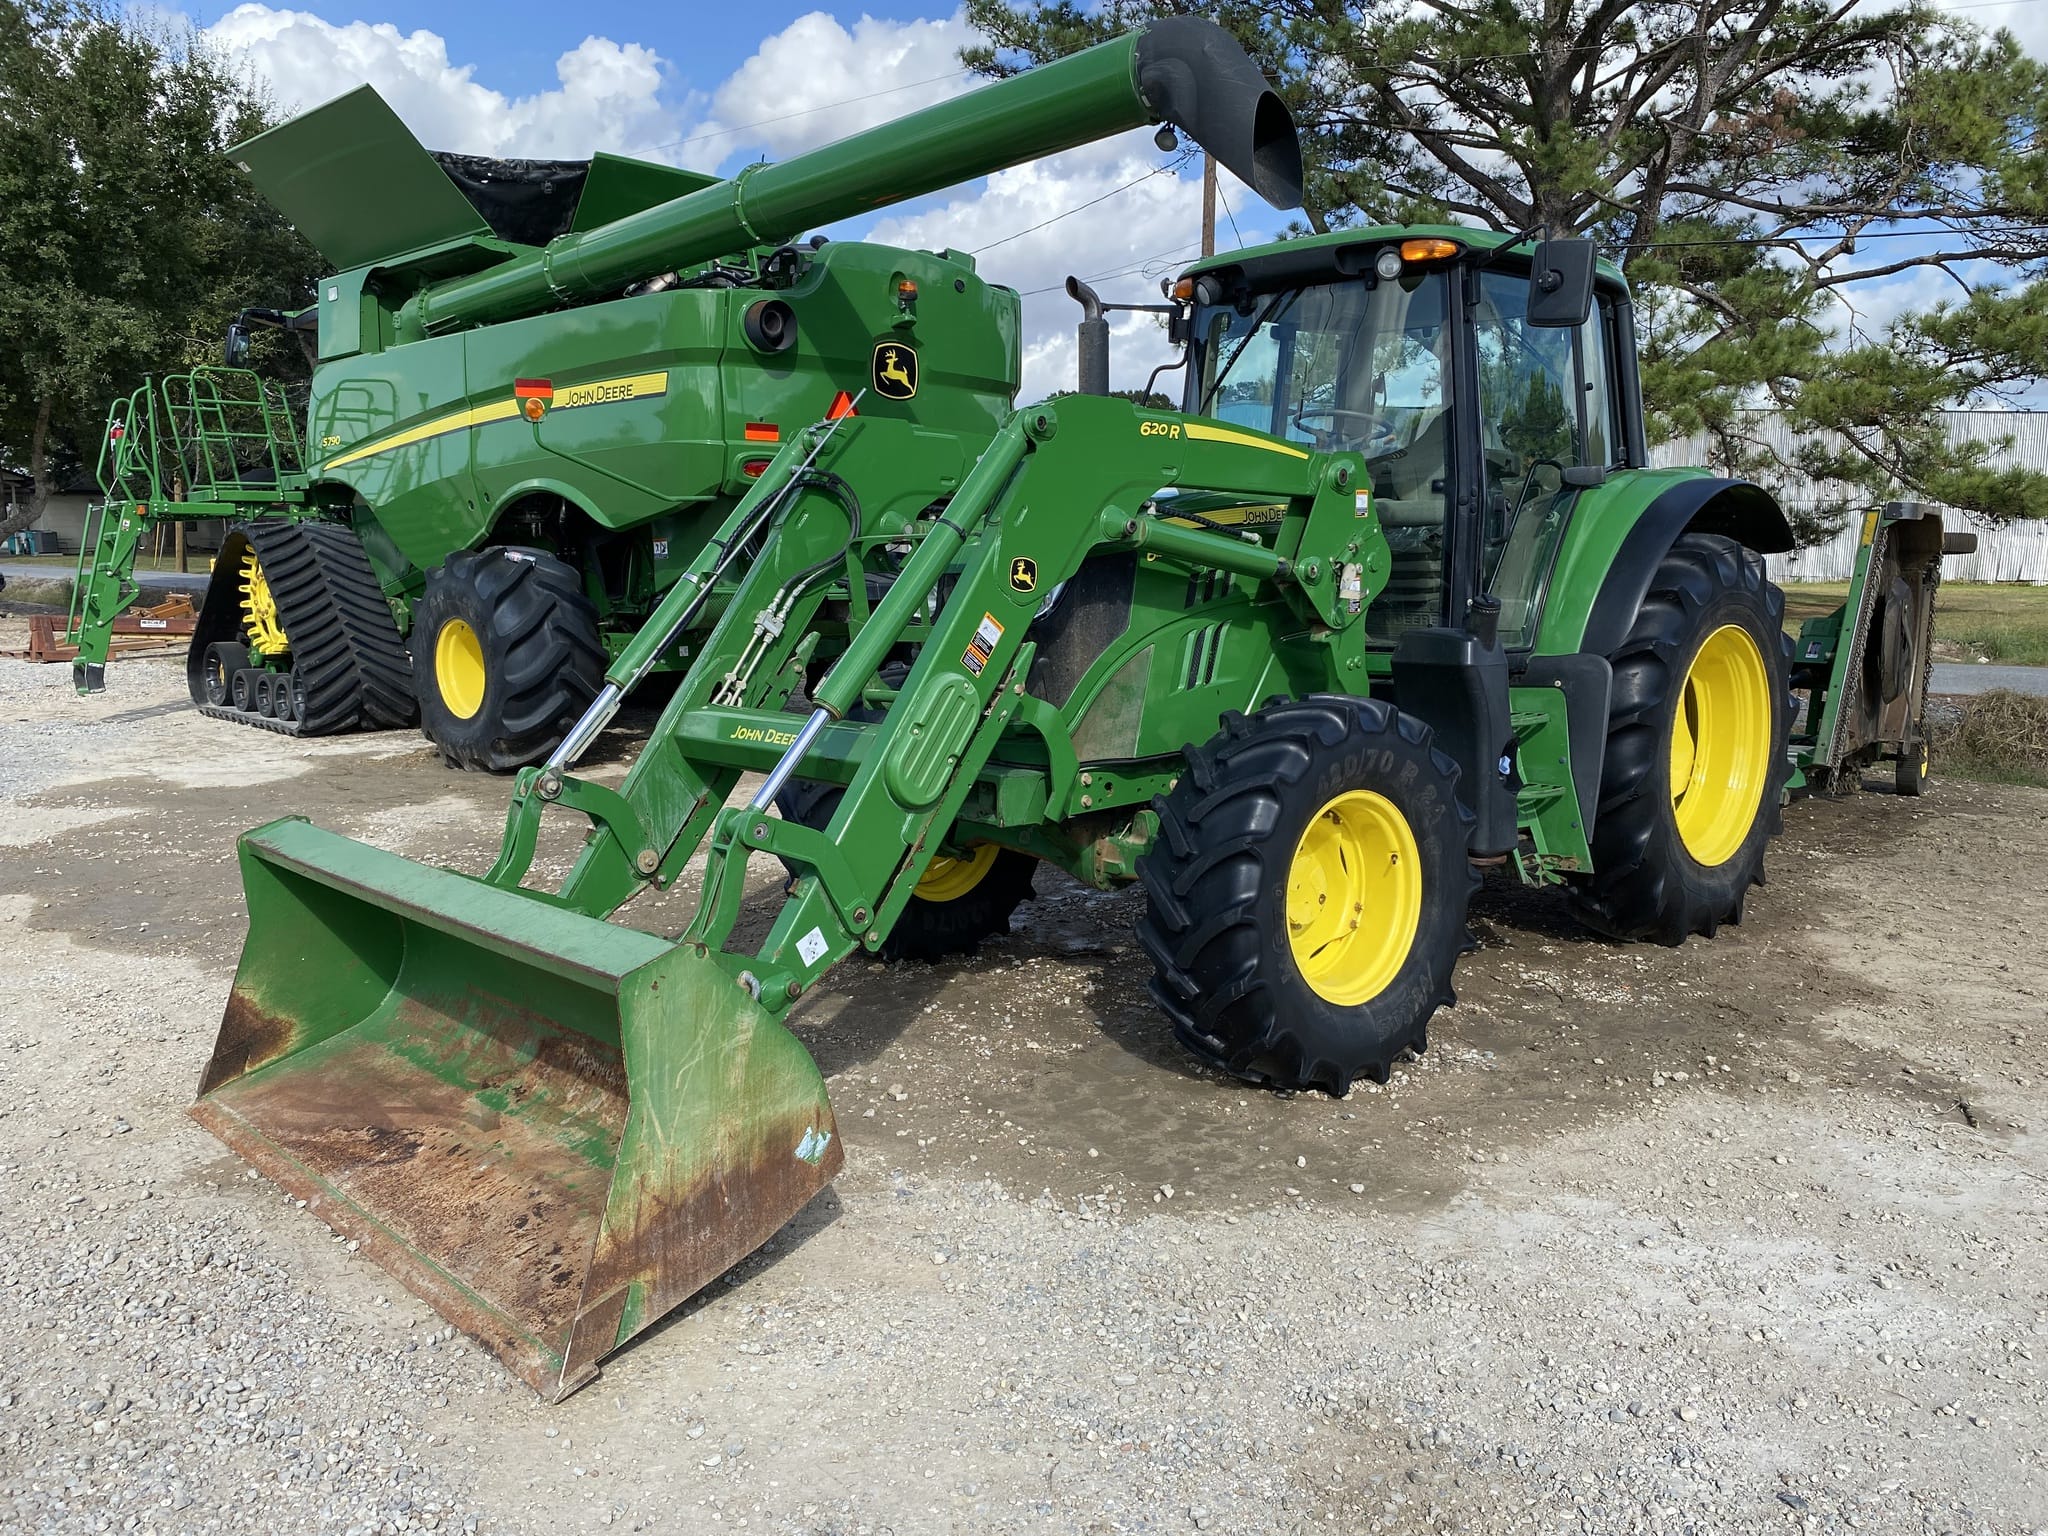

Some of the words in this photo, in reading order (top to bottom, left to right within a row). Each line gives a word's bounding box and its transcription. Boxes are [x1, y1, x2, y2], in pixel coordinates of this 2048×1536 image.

[565, 389, 594, 406] JOHN
[596, 379, 633, 401] DEERE
[1242, 509, 1268, 524] JOHN
[730, 725, 764, 742] JOHN
[764, 728, 799, 745] DEER
